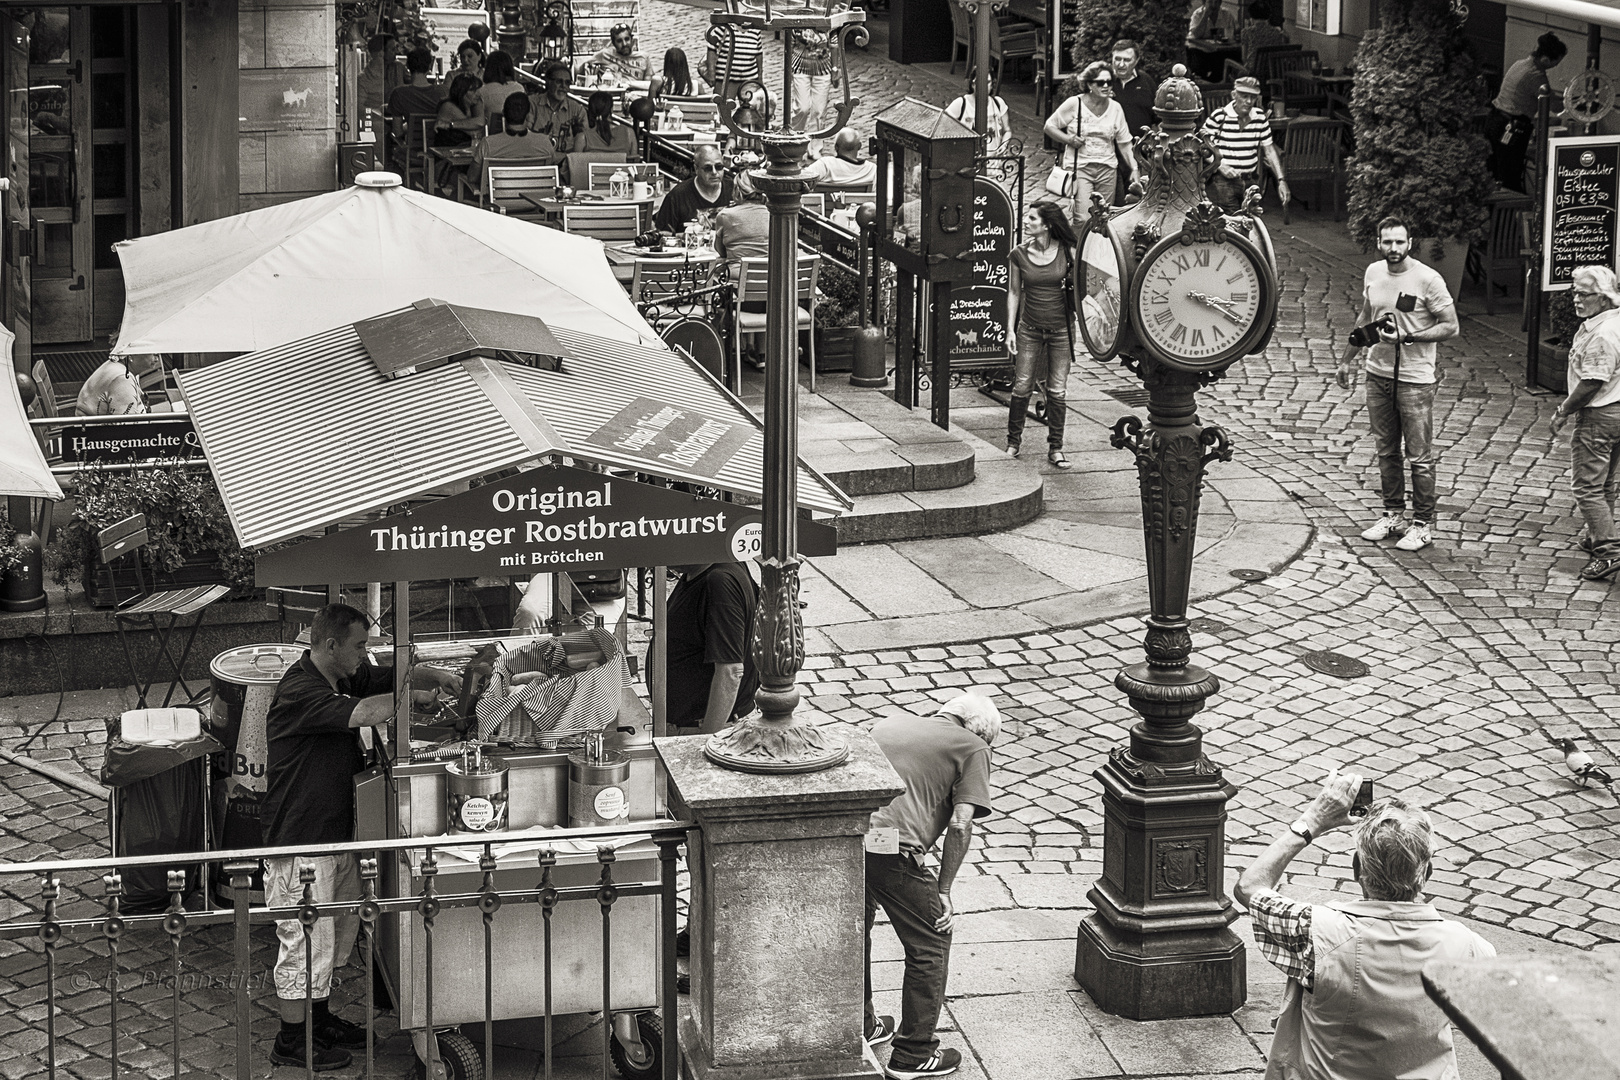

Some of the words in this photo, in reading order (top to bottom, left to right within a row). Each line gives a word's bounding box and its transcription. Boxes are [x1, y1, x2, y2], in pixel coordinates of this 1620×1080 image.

[1563, 180, 1600, 192] Eistee
[72, 433, 180, 453] Hausgemachte
[658, 418, 732, 467] Rostbratwurst
[492, 482, 612, 516] Original
[370, 524, 516, 552] Thüringer
[525, 511, 727, 543] Rostbratwurst
[500, 552, 526, 567] mit
[531, 549, 604, 565] Brötchen
